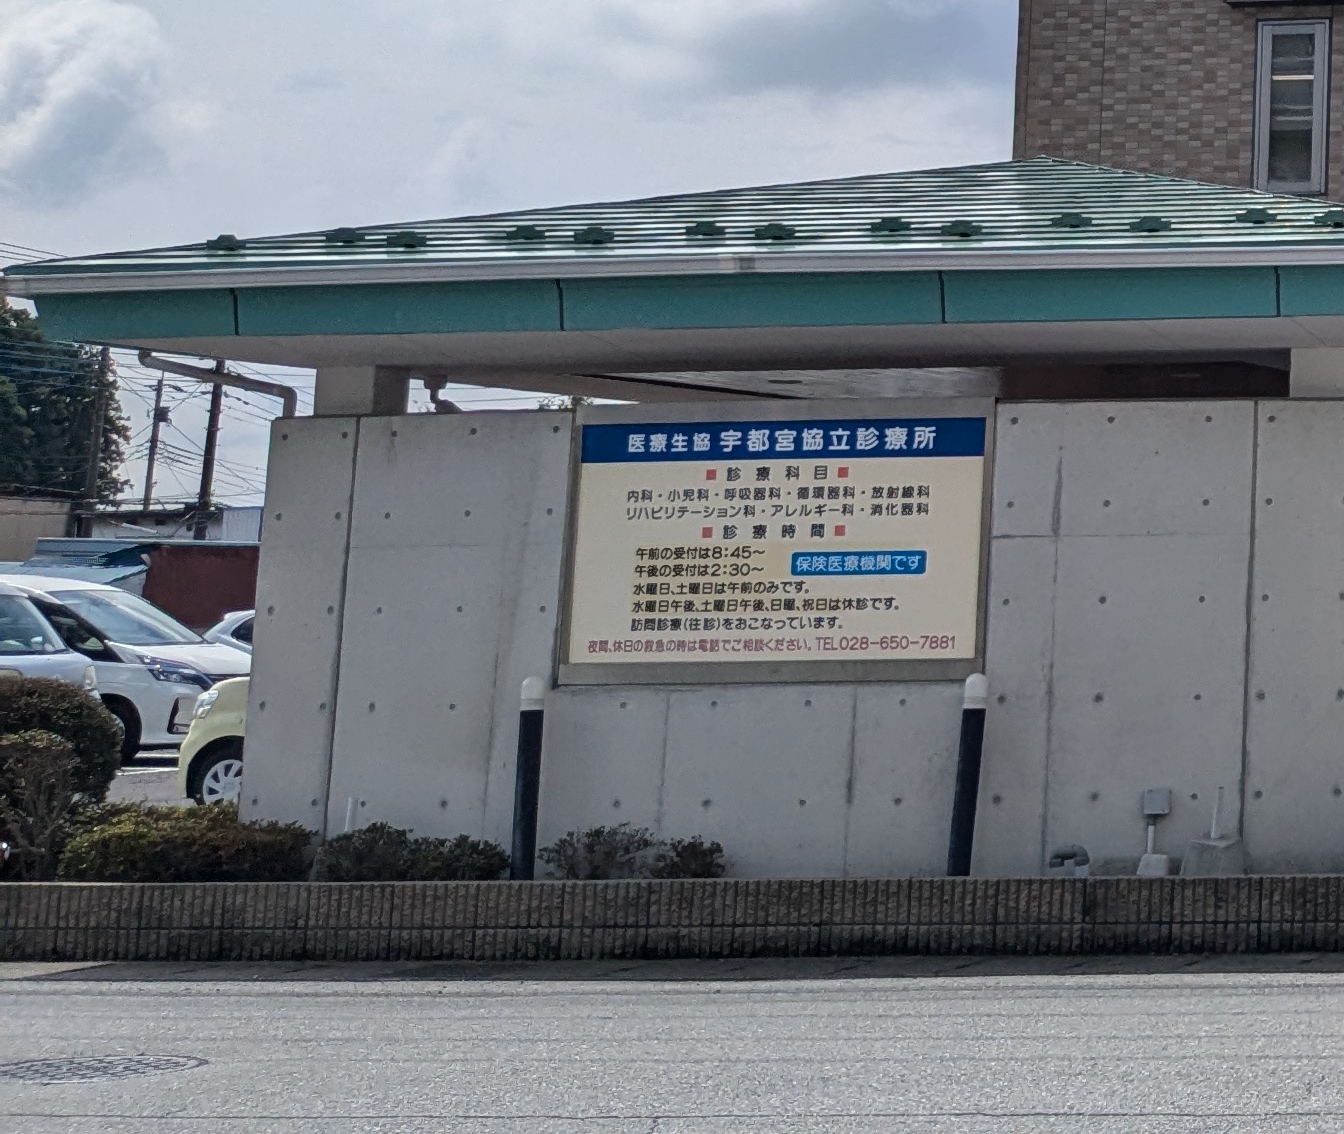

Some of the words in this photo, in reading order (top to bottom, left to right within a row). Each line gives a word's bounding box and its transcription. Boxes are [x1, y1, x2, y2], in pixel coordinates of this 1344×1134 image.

[627, 432, 711, 453] 医療生協
[720, 426, 937, 453] 宇都宮協立診療所
[726, 465, 828, 482] 診療科目
[722, 523, 825, 540] 診療時間
[796, 555, 922, 572] 保険医療機関です
